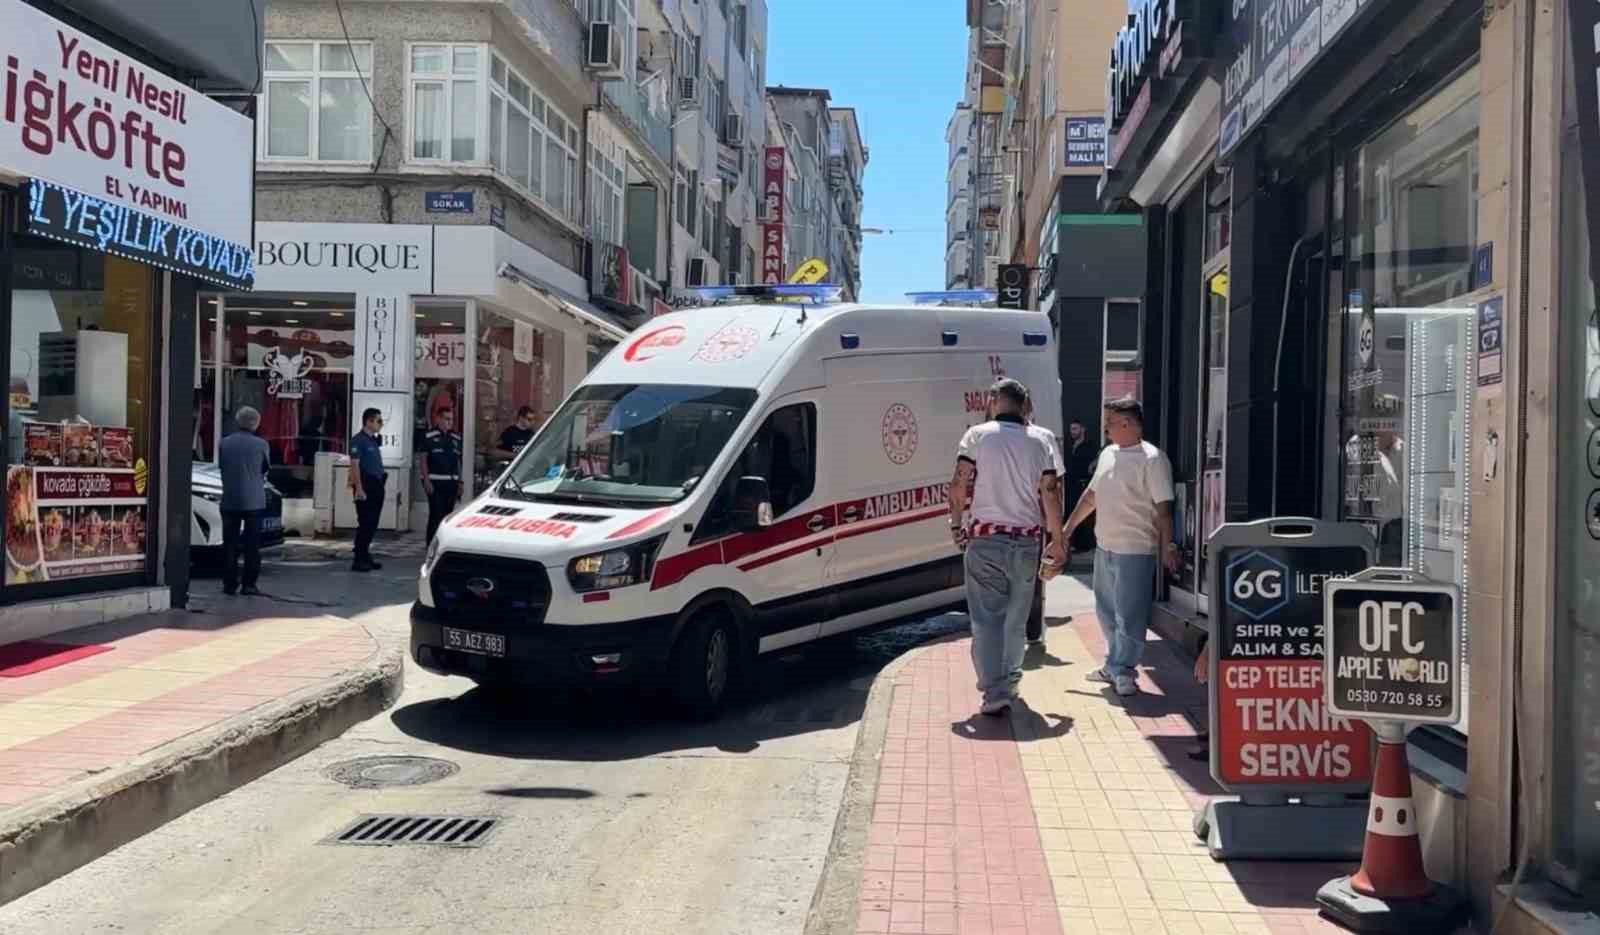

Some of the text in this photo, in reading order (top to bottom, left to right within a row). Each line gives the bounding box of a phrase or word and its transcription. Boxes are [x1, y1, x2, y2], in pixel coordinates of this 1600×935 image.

[57, 30, 187, 125] Yeni Nesil
[105, 176, 187, 219] EL YAPIMI
[432, 200, 465, 208] SOKAK
[258, 240, 420, 273] BOUTIQUE
[43, 472, 77, 493] kovada
[1233, 570, 1282, 599] 6G
[1236, 625, 1282, 638] SIFIR
[1287, 626, 1309, 638] ve
[1358, 600, 1425, 654] OFC
[449, 631, 503, 652] 55 AEZ 983
[1231, 643, 1277, 656] ALIM
[1281, 643, 1295, 656] &
[1225, 666, 1262, 688] CEP
[1337, 655, 1383, 680] APPLE
[1347, 689, 1442, 708] 0530 720 58 55
